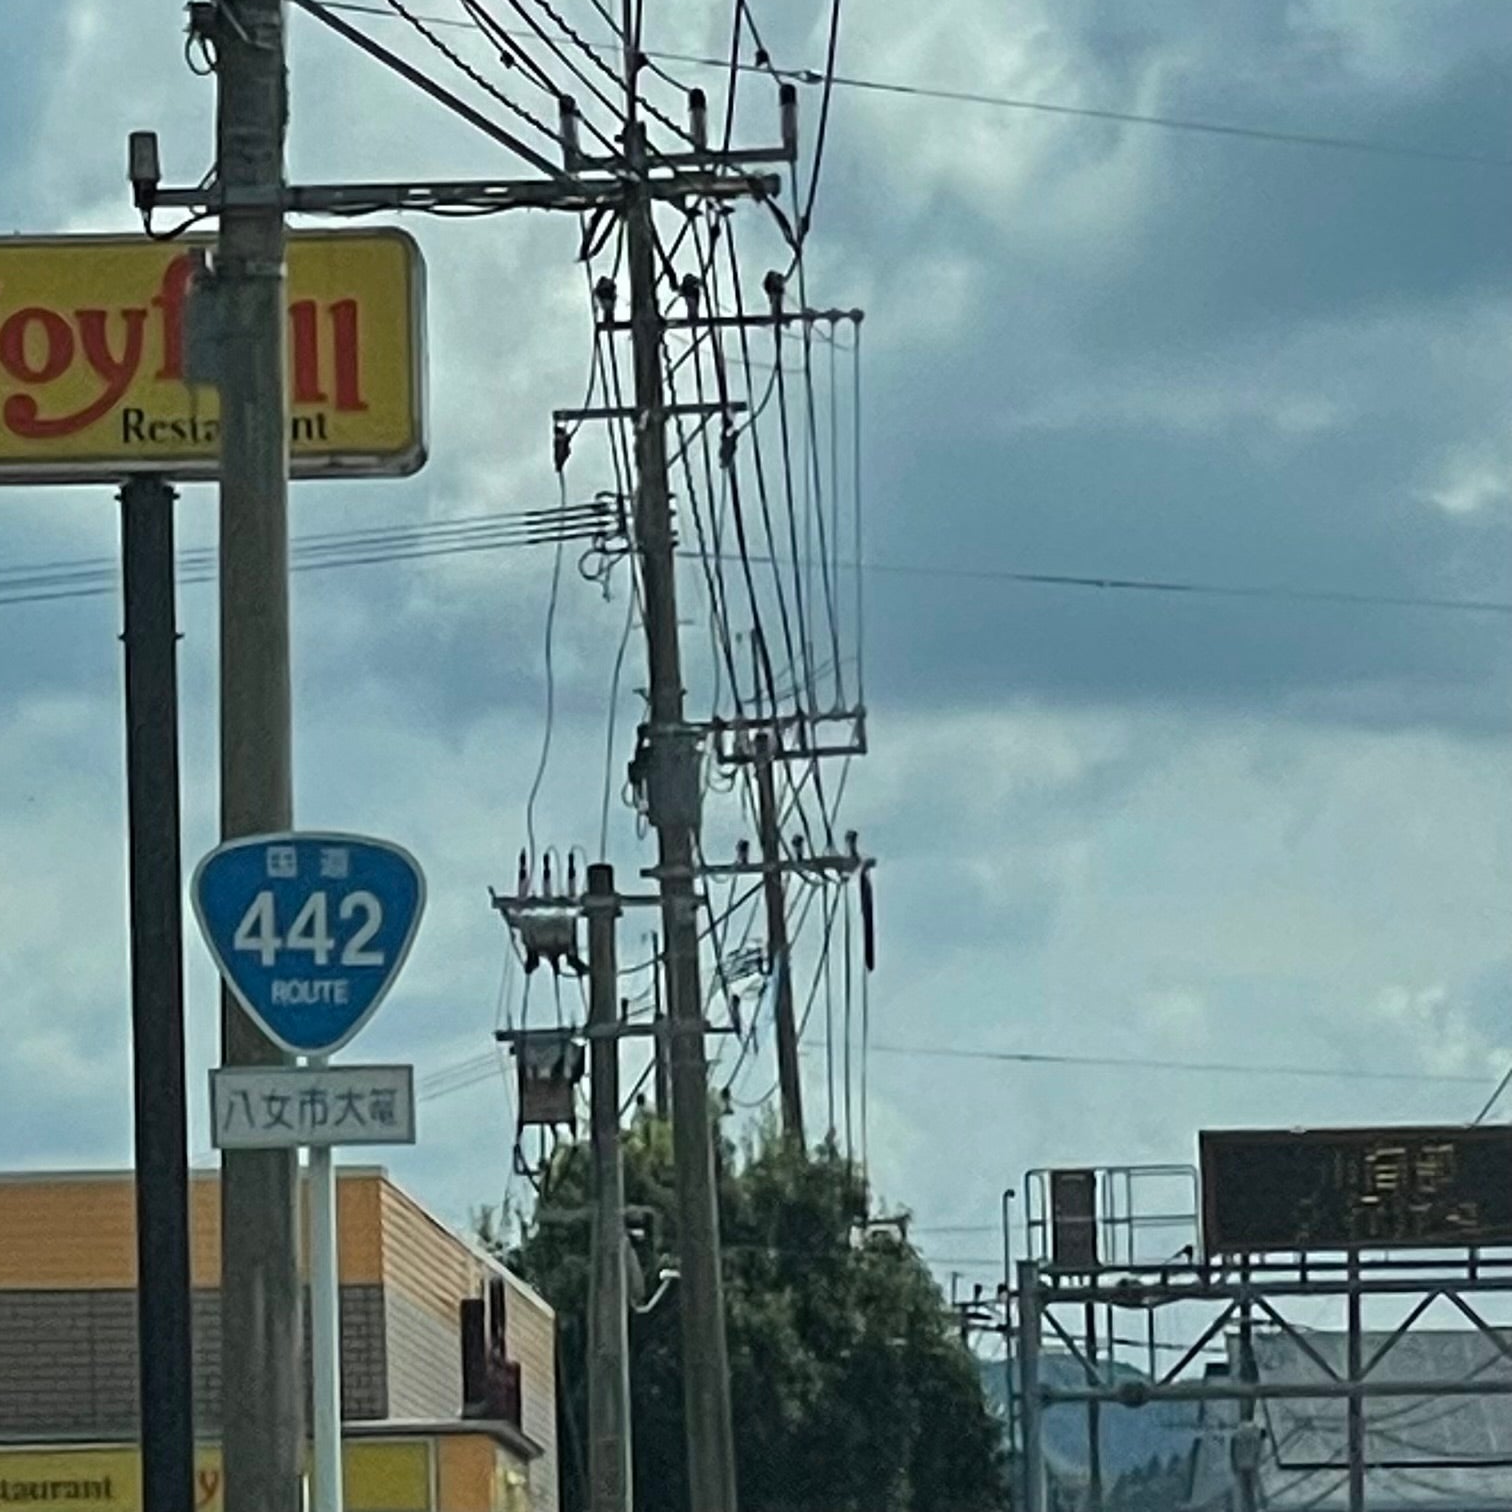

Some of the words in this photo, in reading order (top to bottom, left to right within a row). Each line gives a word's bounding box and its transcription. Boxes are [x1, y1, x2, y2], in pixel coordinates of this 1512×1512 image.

[122, 407, 329, 445] Restant
[233, 890, 385, 967] 442
[270, 979, 348, 1004] ROUTE
